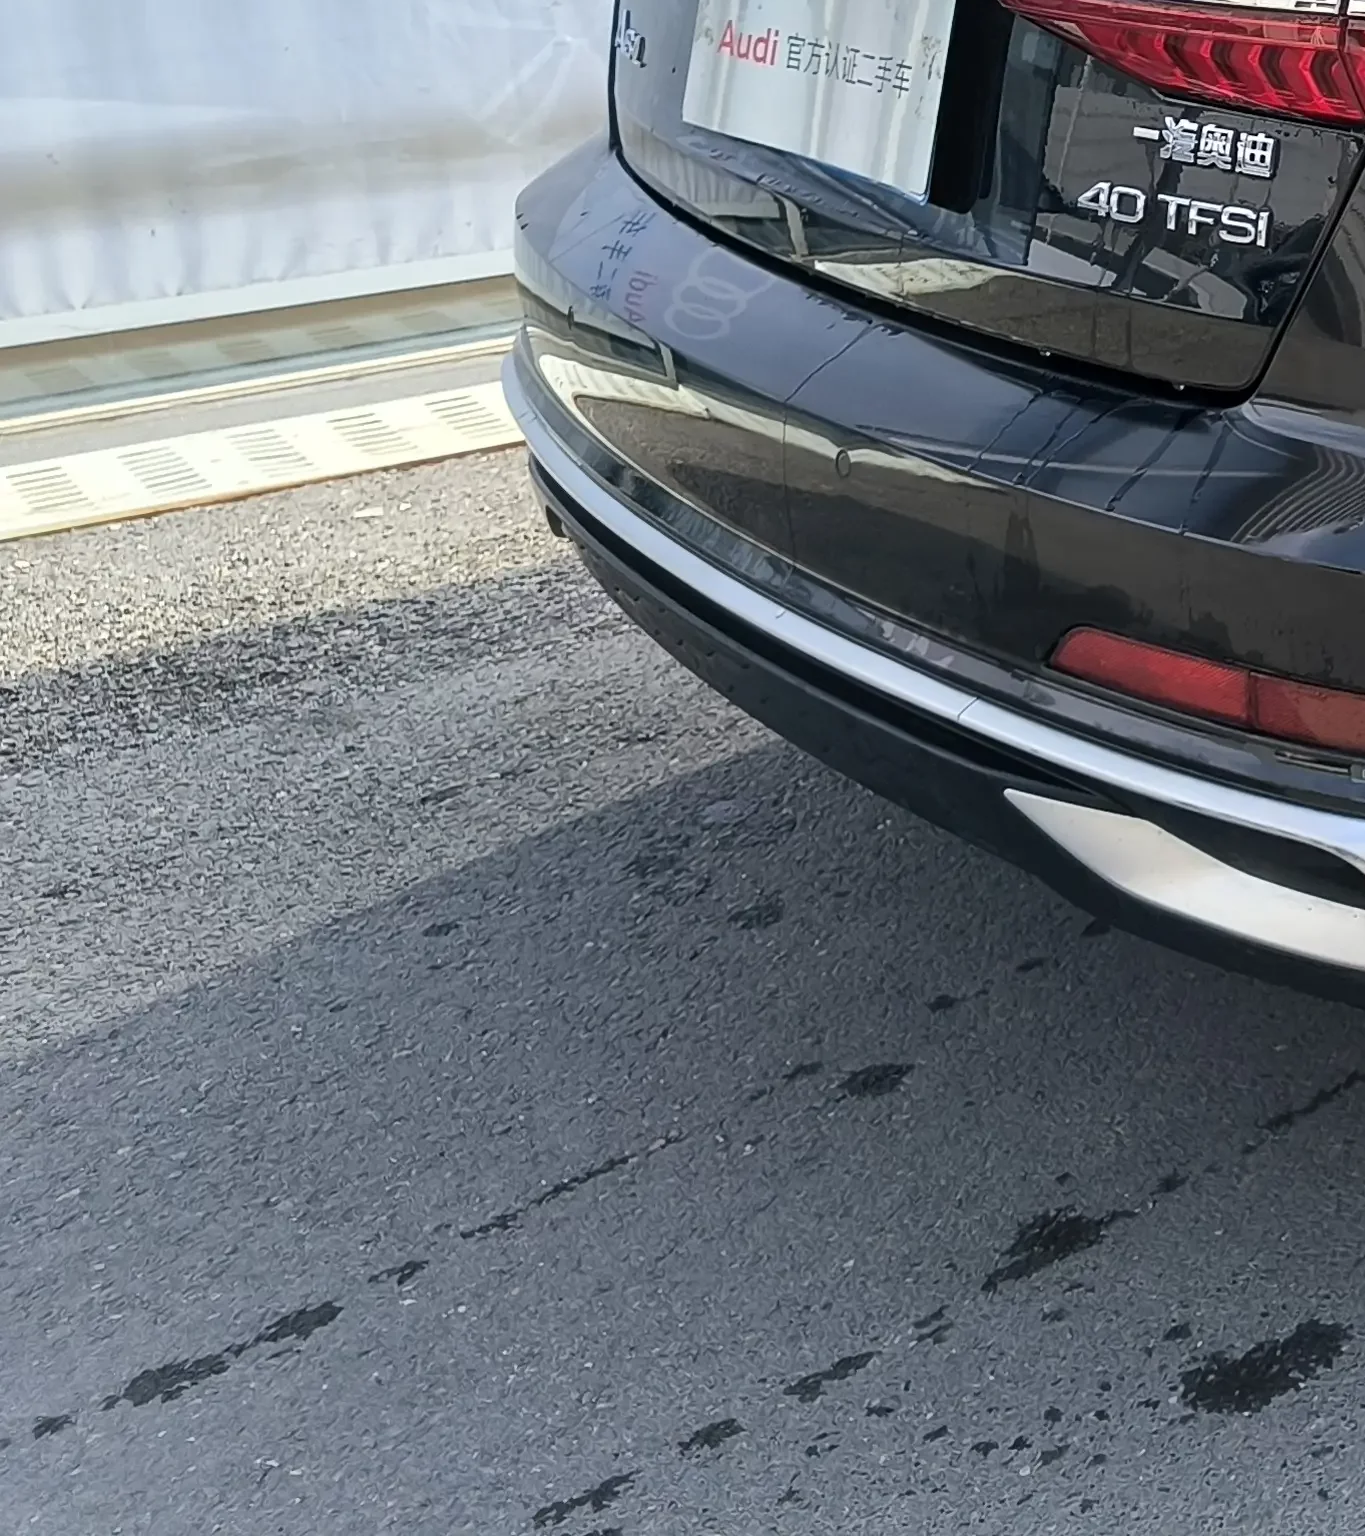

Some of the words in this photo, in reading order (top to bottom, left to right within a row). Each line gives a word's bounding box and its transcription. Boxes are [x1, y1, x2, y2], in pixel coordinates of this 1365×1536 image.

[717, 19, 780, 67] Audi
[785, 32, 913, 99] 官方认证二手车
[1133, 116, 1276, 178] 一汽奥迪
[1077, 181, 1146, 224] 40
[1157, 193, 1270, 248] TFSI
